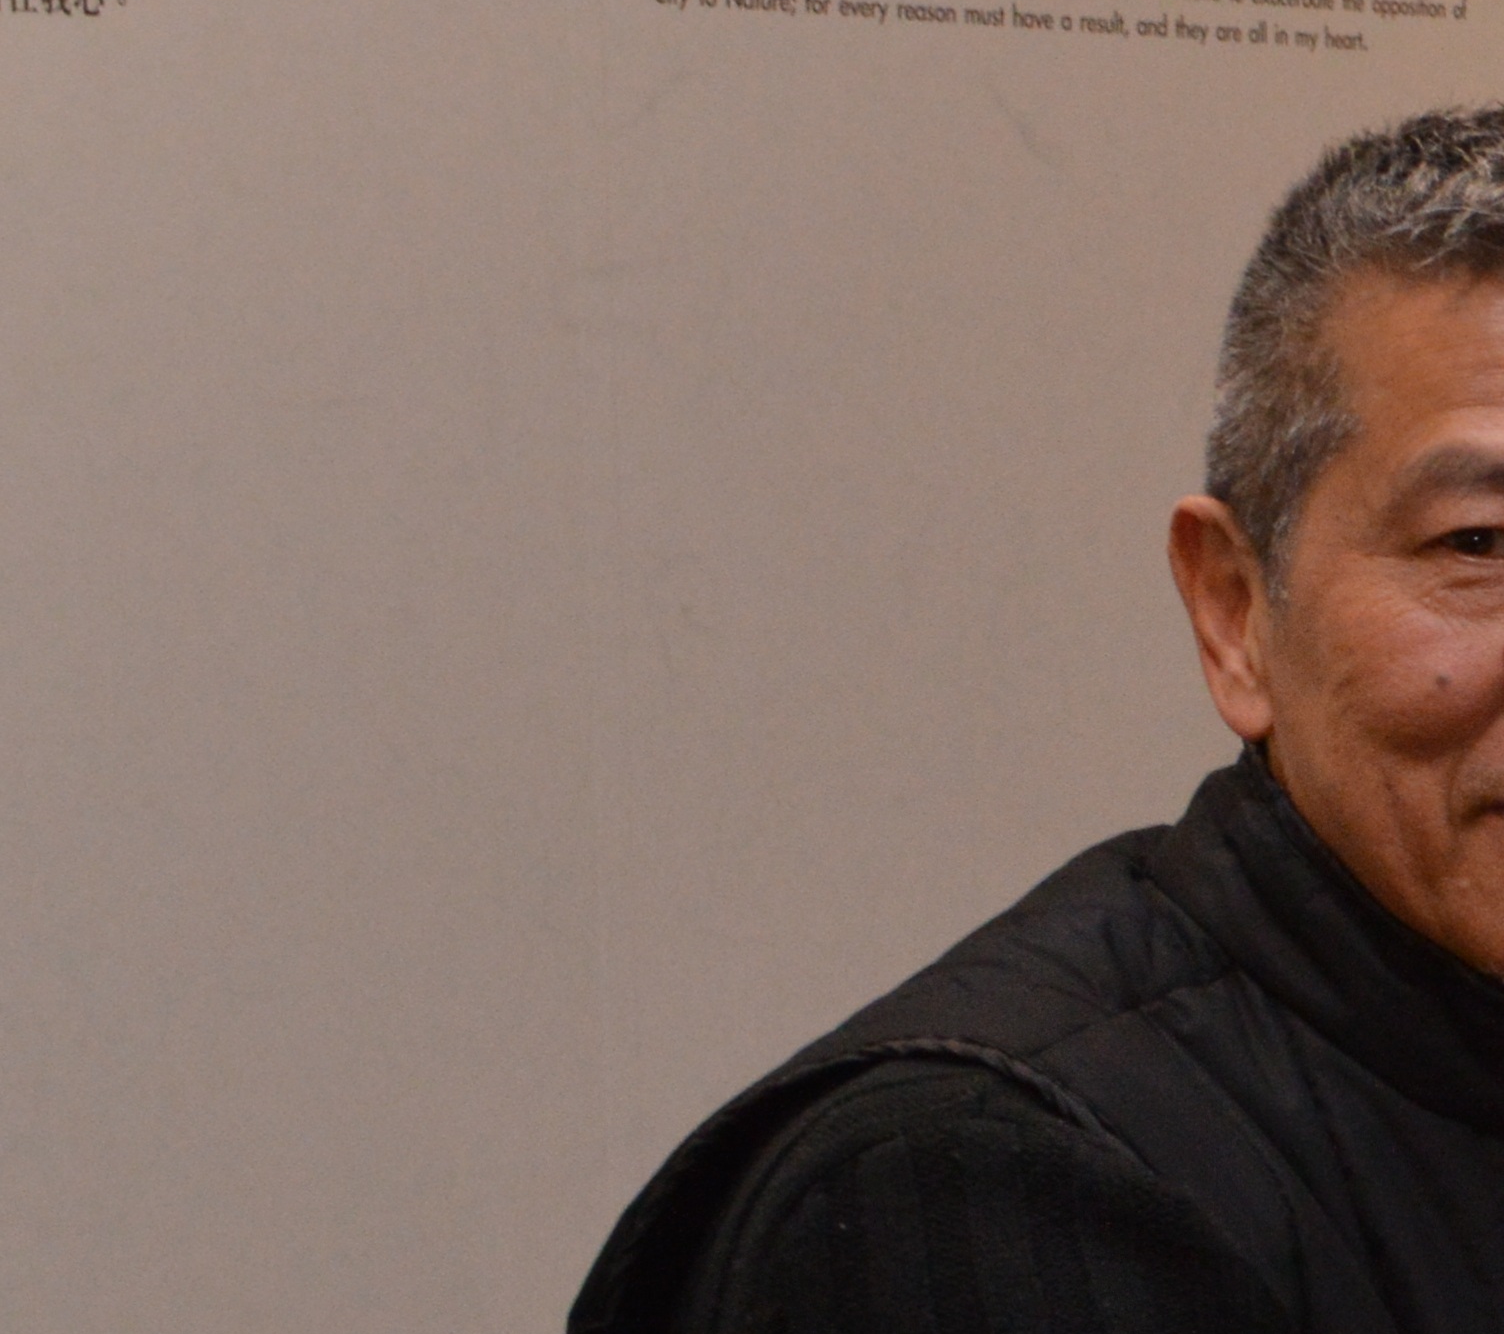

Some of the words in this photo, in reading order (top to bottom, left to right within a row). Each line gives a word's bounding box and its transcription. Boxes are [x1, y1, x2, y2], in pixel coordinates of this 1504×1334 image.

[897, 2, 957, 25] reason
[965, 7, 1005, 28] must
[1012, 3, 1054, 31] have
[1061, 14, 1073, 32] a
